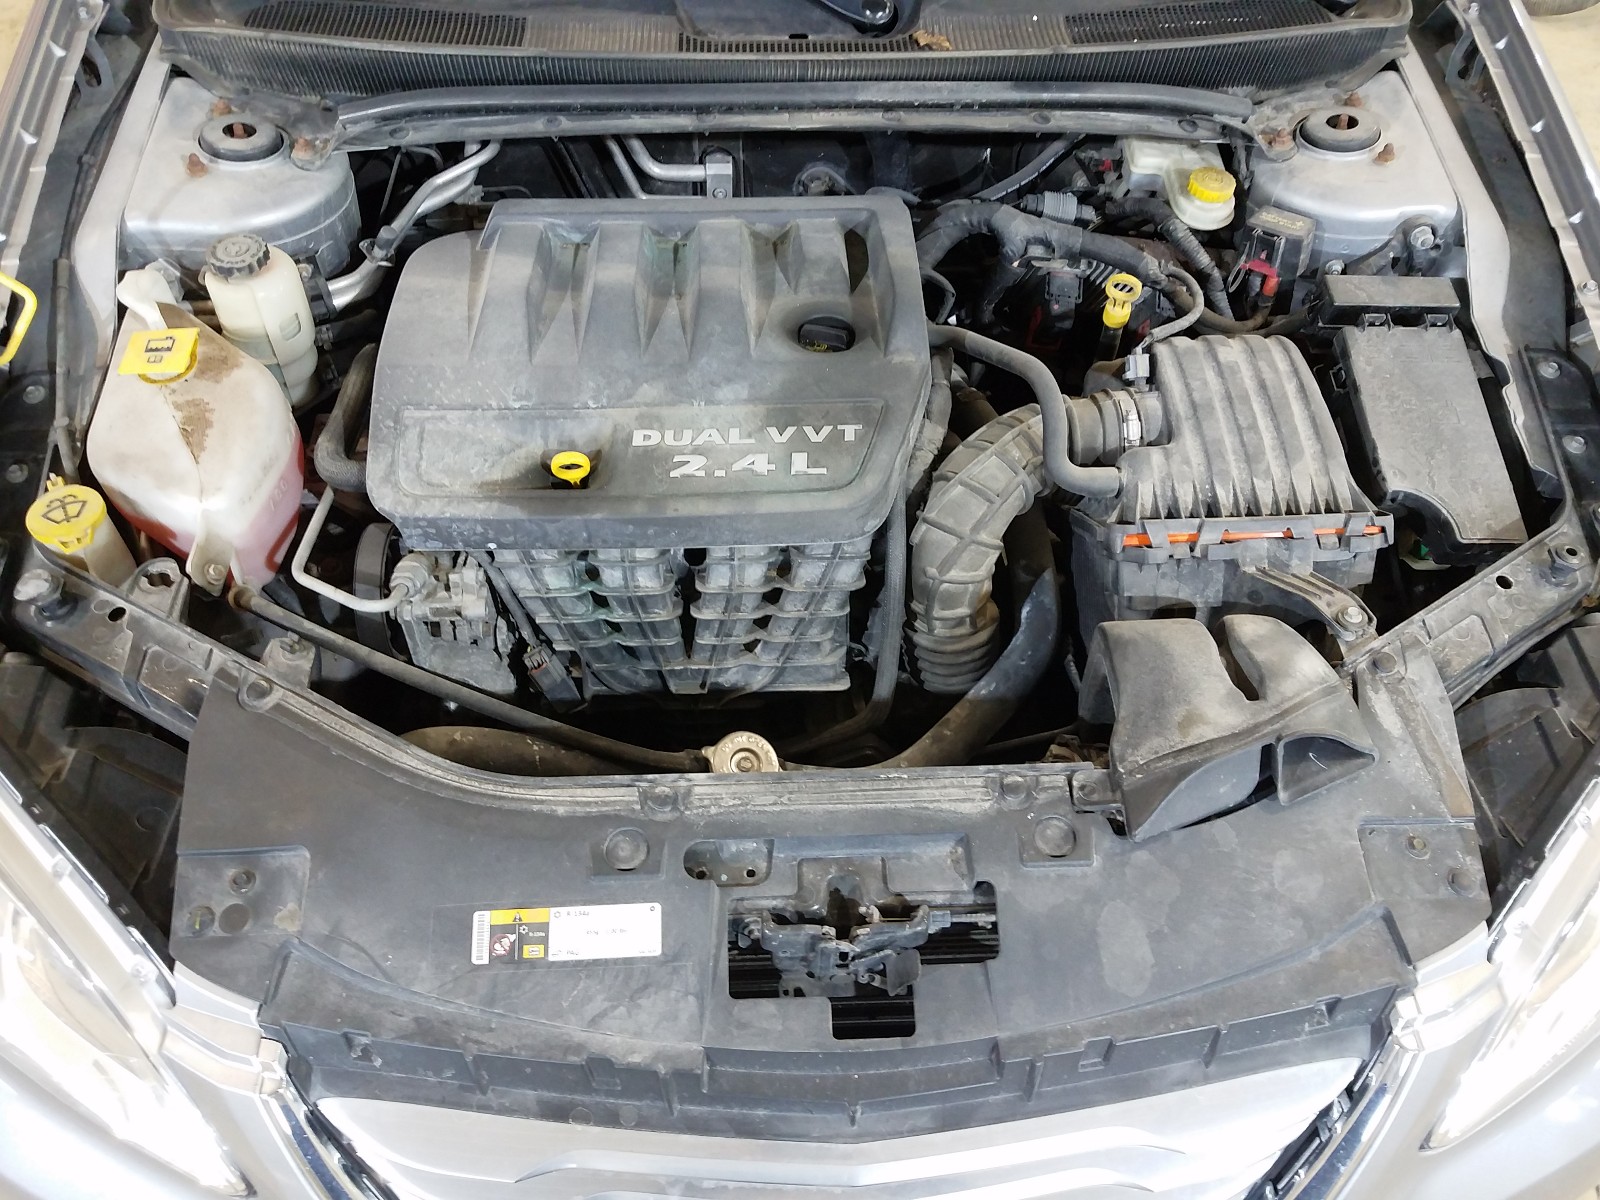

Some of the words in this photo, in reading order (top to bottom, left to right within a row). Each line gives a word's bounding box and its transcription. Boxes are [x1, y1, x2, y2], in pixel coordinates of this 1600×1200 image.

[632, 427, 756, 447] DUAL
[766, 424, 863, 443] VVT
[669, 453, 776, 478] 2.4
[790, 451, 828, 476] L
